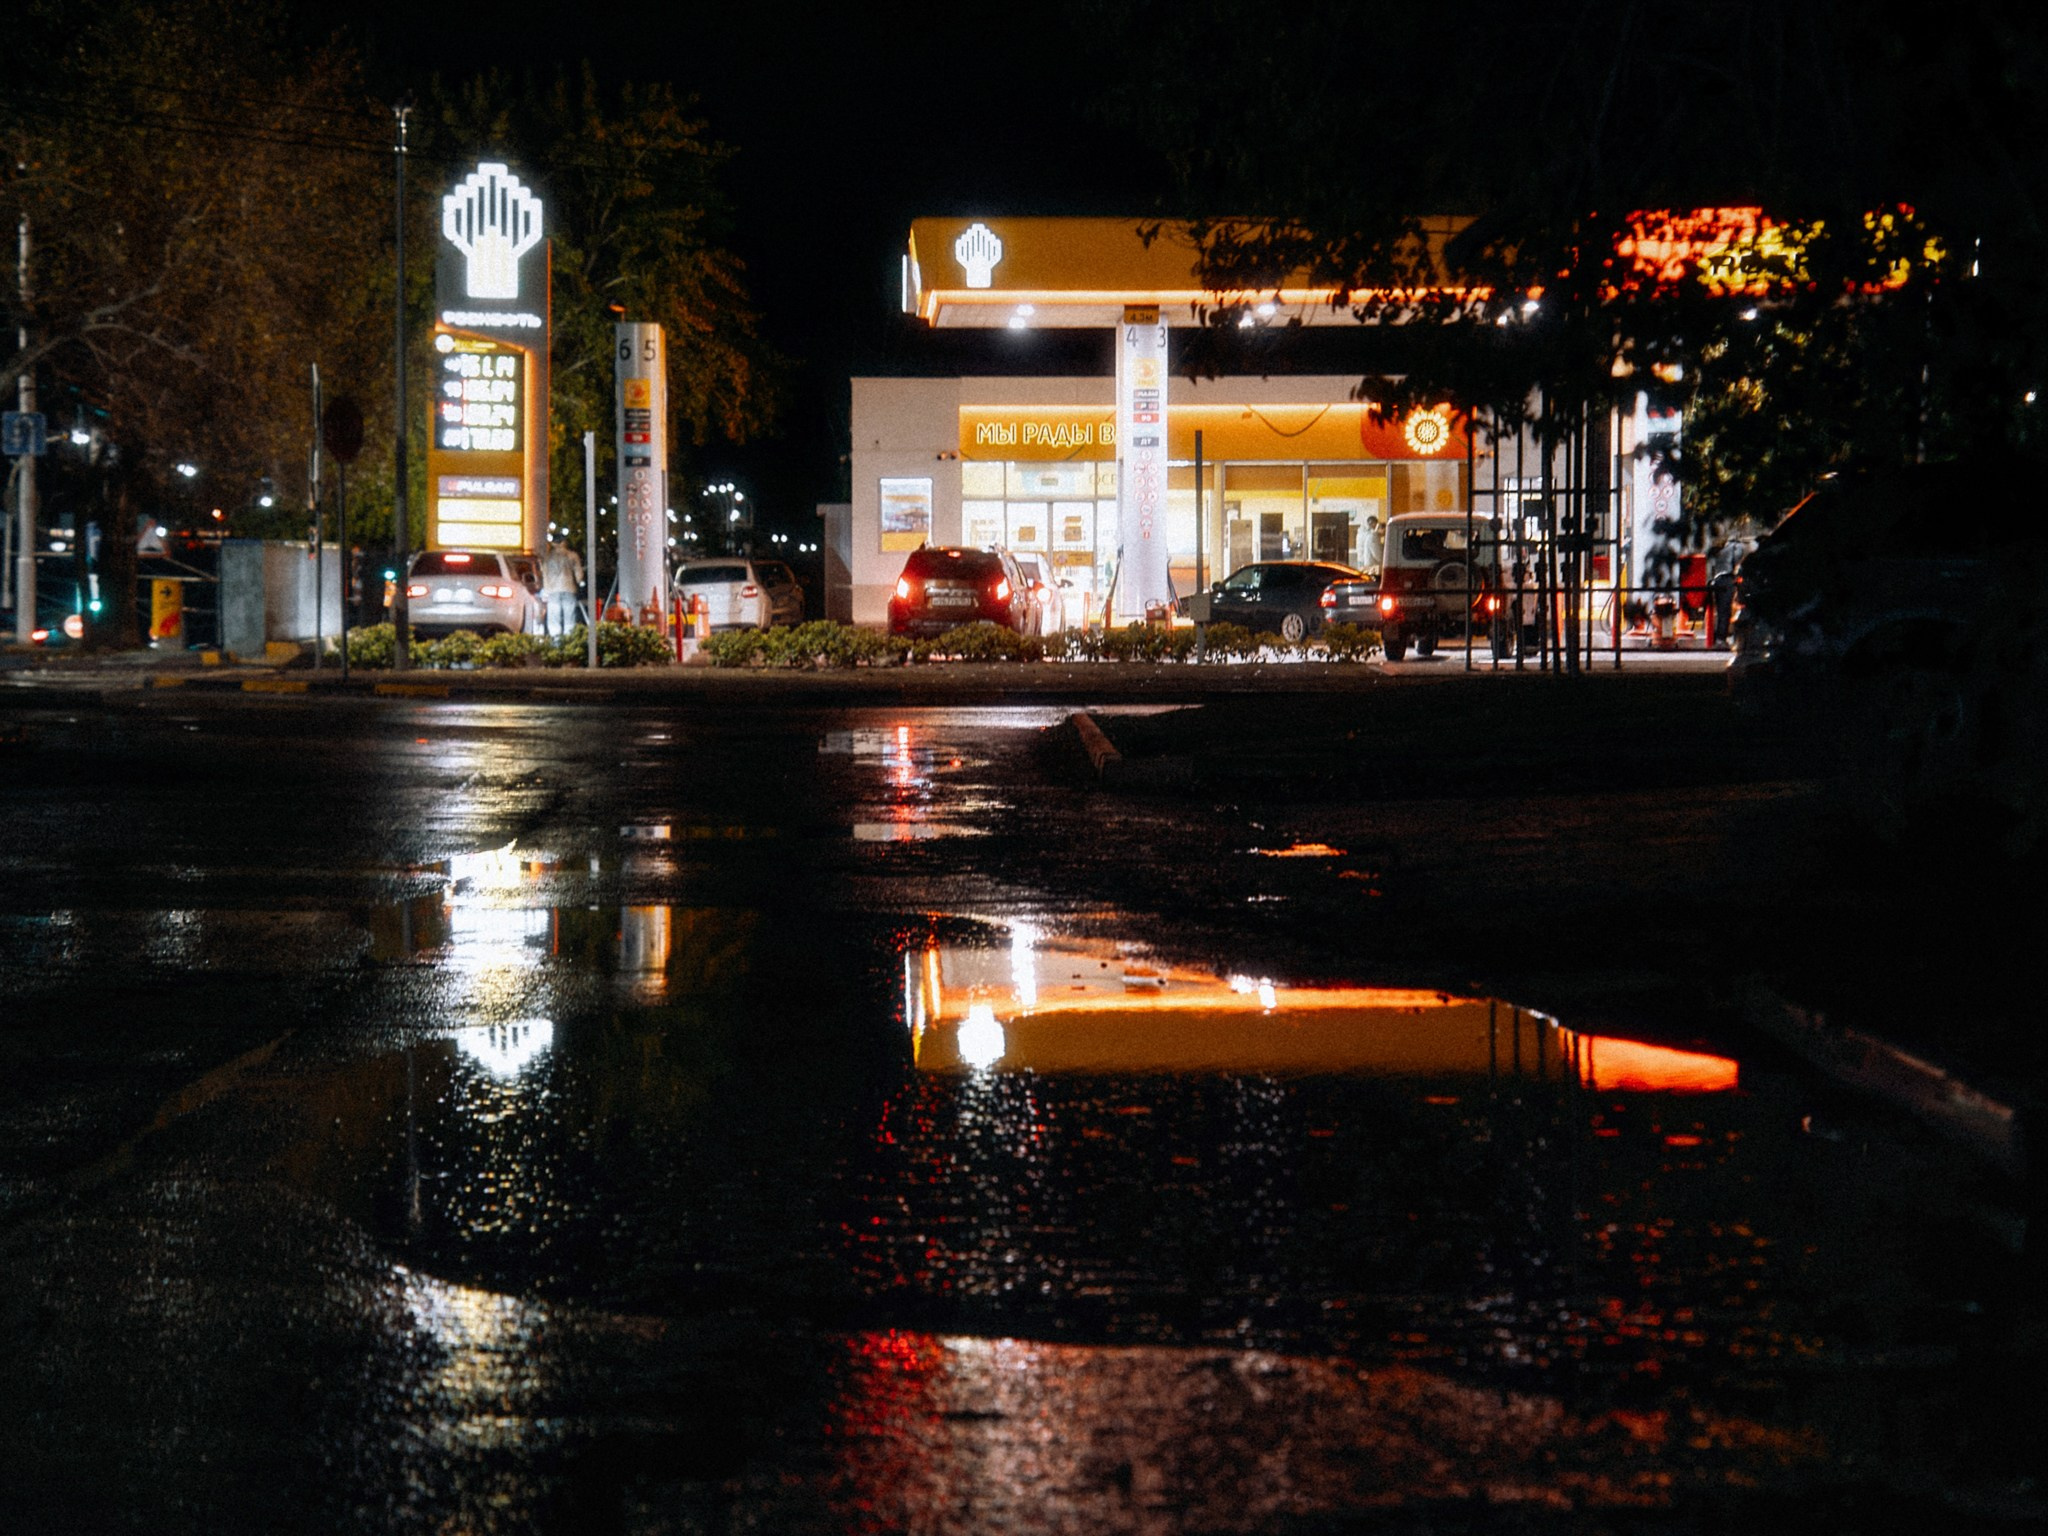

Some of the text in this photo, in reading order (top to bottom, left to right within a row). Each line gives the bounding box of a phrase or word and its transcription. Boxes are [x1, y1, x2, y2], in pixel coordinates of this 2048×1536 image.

[1126, 326, 1167, 348] 4 3
[619, 338, 656, 362] 6 5
[976, 422, 1117, 448] МЫ РАДЫ В
